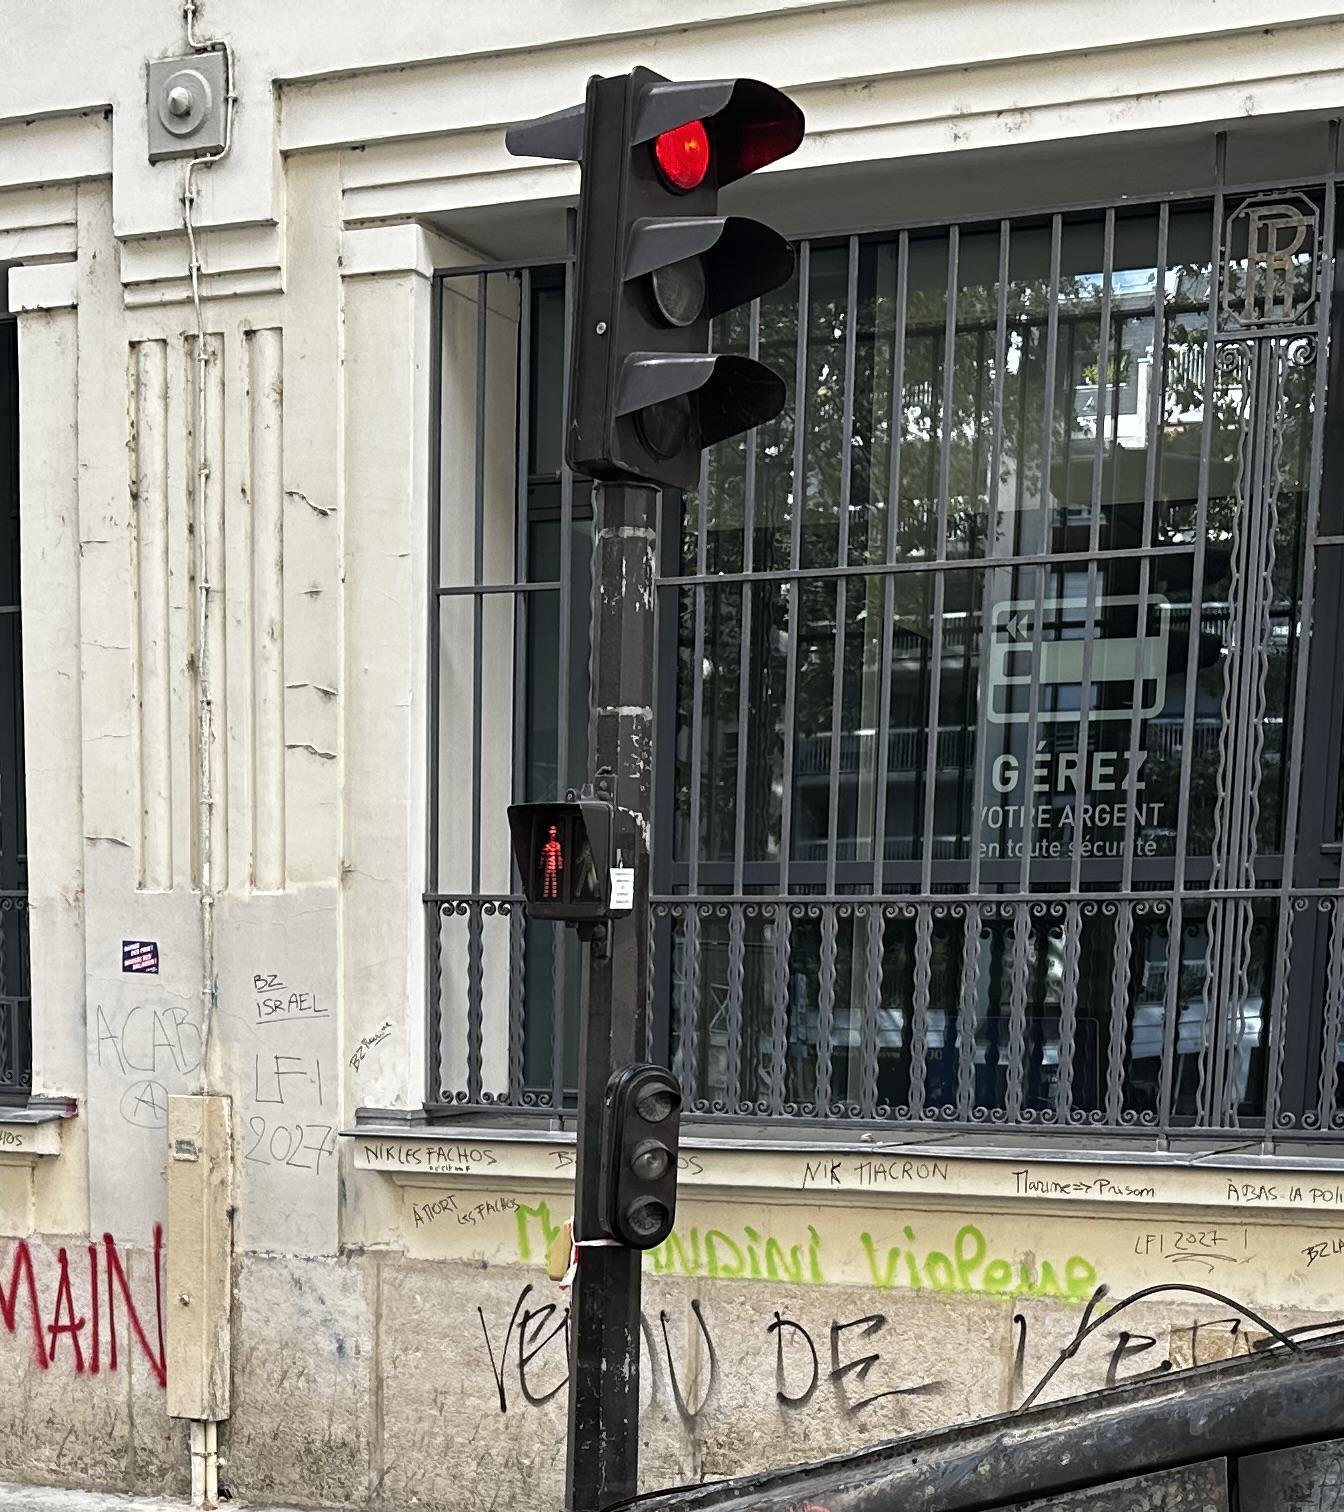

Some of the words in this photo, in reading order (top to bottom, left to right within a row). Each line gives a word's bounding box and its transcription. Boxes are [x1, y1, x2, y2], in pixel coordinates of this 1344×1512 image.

[991, 739, 1149, 793] GÉREZ
[1058, 802, 1165, 829] ARGENT
[1068, 834, 1158, 858] sécurté
[96, 1003, 203, 1076] ACAB
[243, 1116, 338, 1176] 2027
[363, 1143, 395, 1164] NIK
[425, 1145, 498, 1166] FACHOS
[802, 1158, 843, 1189] NIK
[854, 1160, 950, 1185] MACRON
[1173, 1230, 1229, 1252] 2027
